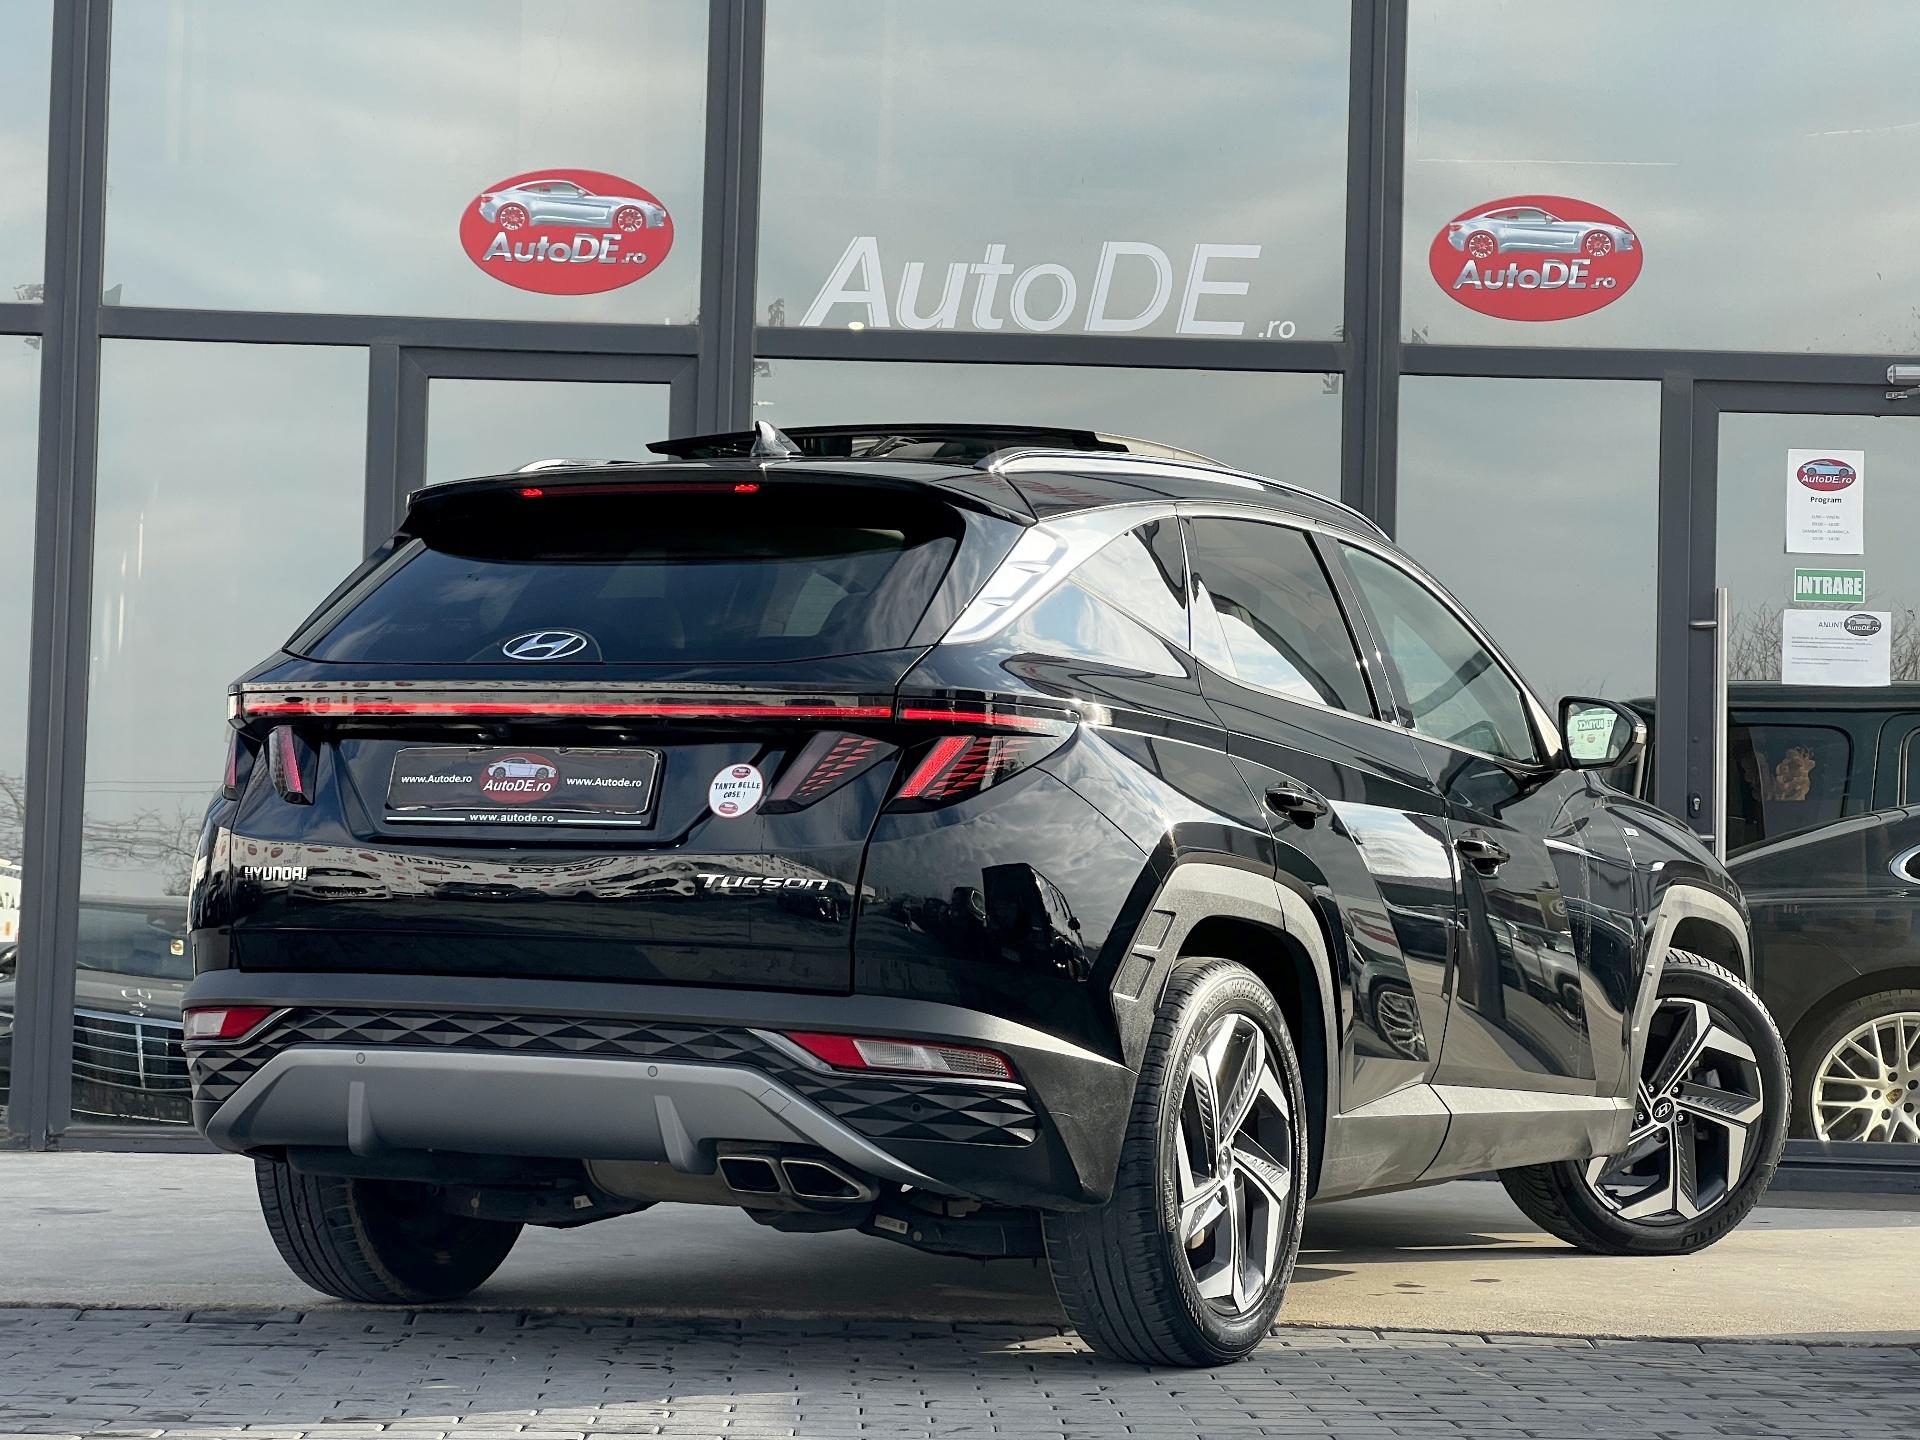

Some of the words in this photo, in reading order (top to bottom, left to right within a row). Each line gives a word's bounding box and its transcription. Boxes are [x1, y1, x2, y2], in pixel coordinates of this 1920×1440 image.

[1810, 496, 1842, 505] Program
[1796, 575, 1863, 596] INTRARE
[401, 775, 473, 783] www.Autode.ro
[566, 776, 642, 788] www.Autode.ro
[482, 779, 552, 792] AutoDE.ro
[714, 782, 736, 790] TANTE
[737, 781, 761, 789] BELLE
[469, 813, 555, 823] www.autode.ro
[244, 866, 308, 881] HYUNDAI
